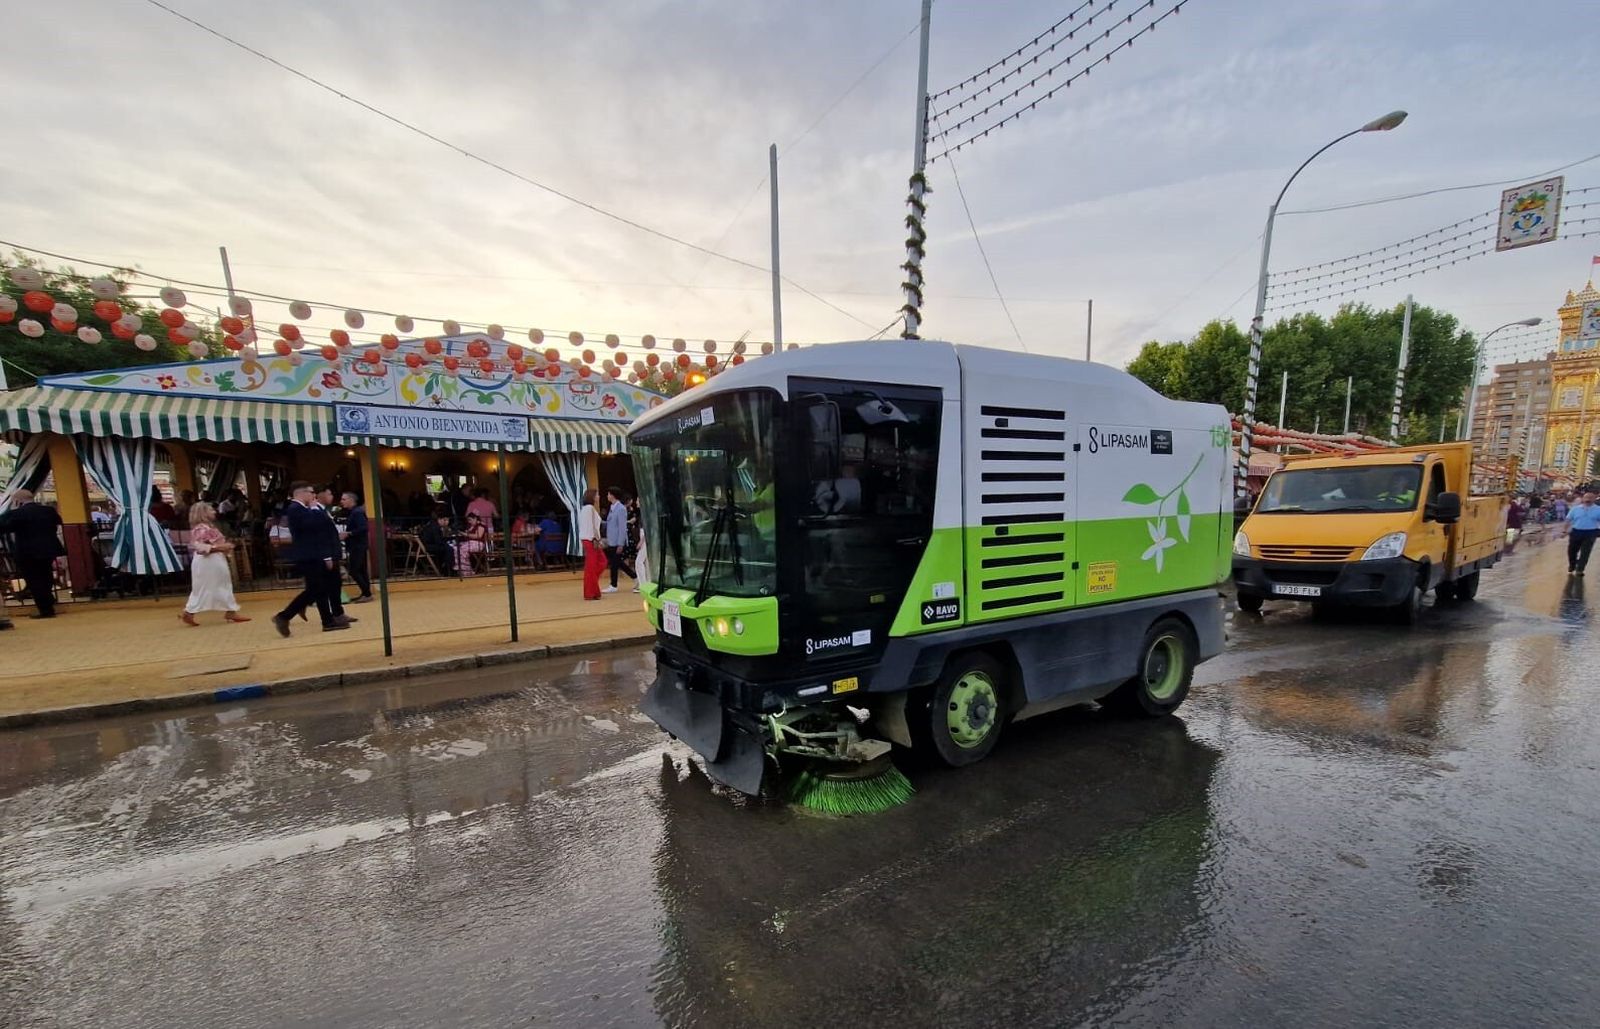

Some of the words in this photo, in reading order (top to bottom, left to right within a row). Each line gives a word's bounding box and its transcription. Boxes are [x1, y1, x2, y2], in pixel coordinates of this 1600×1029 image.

[374, 415, 429, 431] ANTONIO
[432, 417, 500, 435] BIENVENIDA
[1101, 433, 1148, 449] LIPASAM
[936, 604, 958, 615] RAVO
[814, 635, 851, 650] LIPASAM
